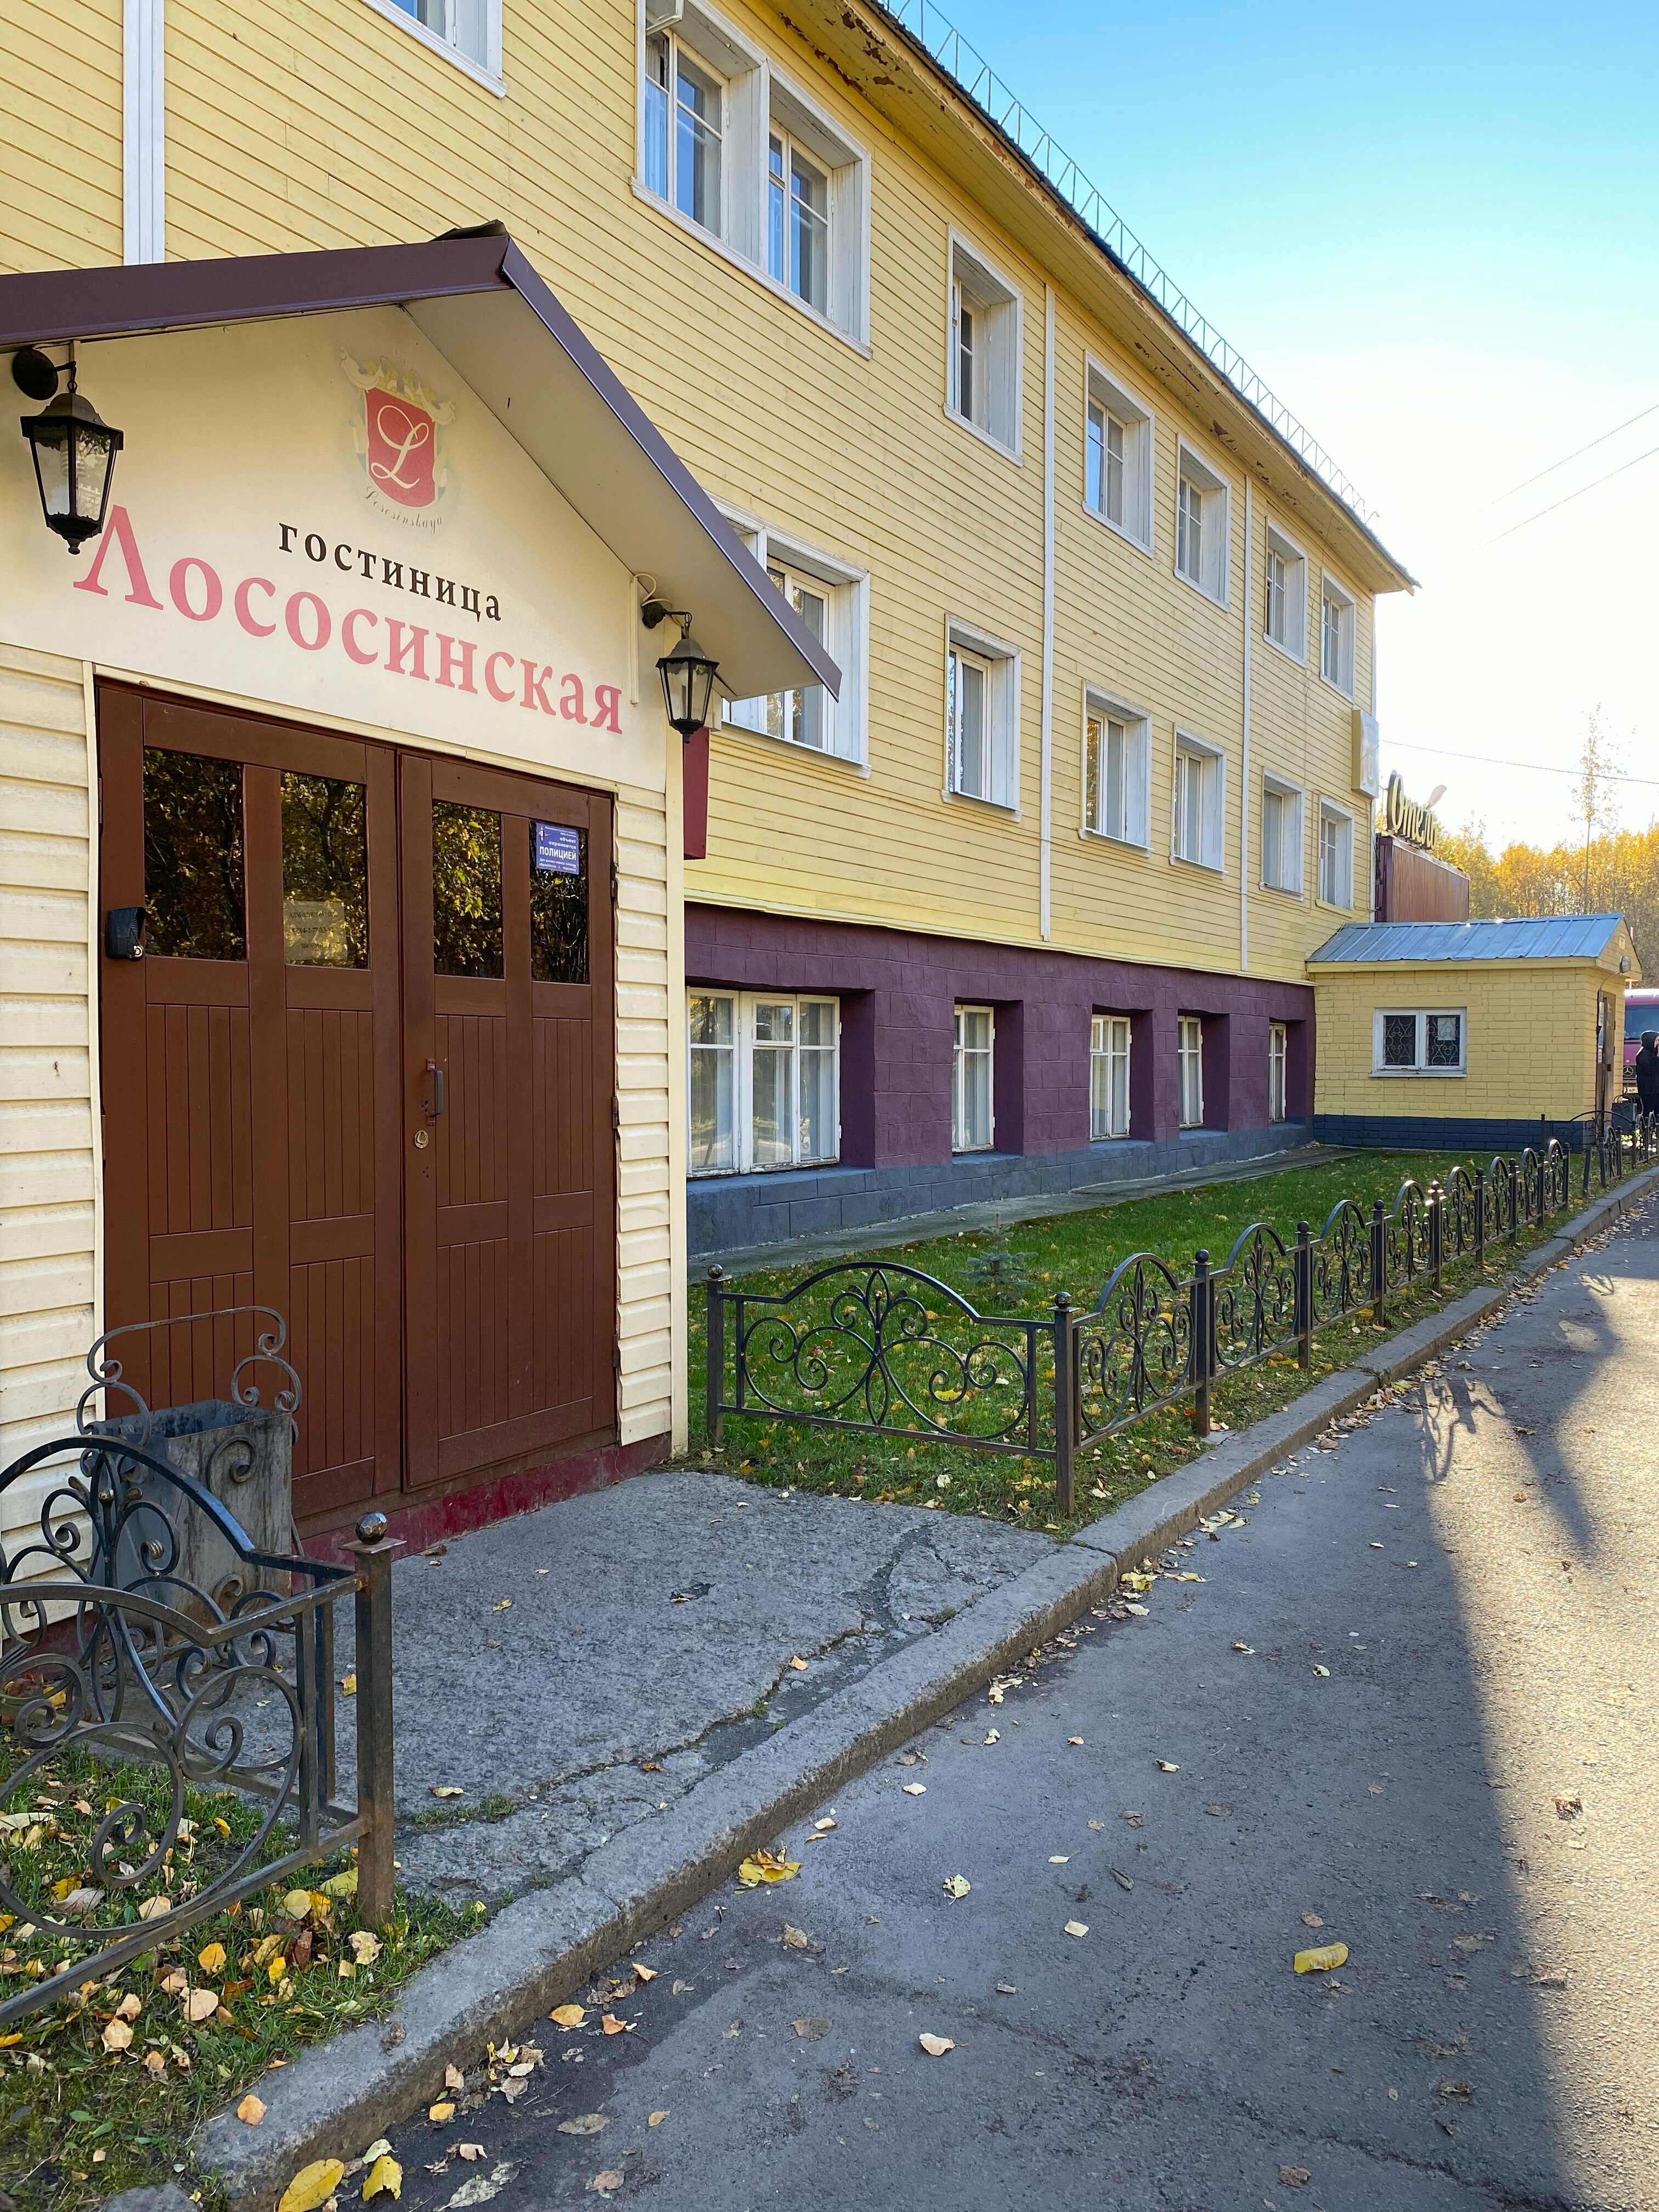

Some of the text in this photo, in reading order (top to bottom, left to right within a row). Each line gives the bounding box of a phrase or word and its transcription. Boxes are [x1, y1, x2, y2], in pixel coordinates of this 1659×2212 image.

[278, 522, 501, 622] гостиница
[73, 504, 623, 734] Лососинская
[539, 845, 577, 861] ПОЛИЦИЕЙ
[1389, 771, 1436, 850] Отель
